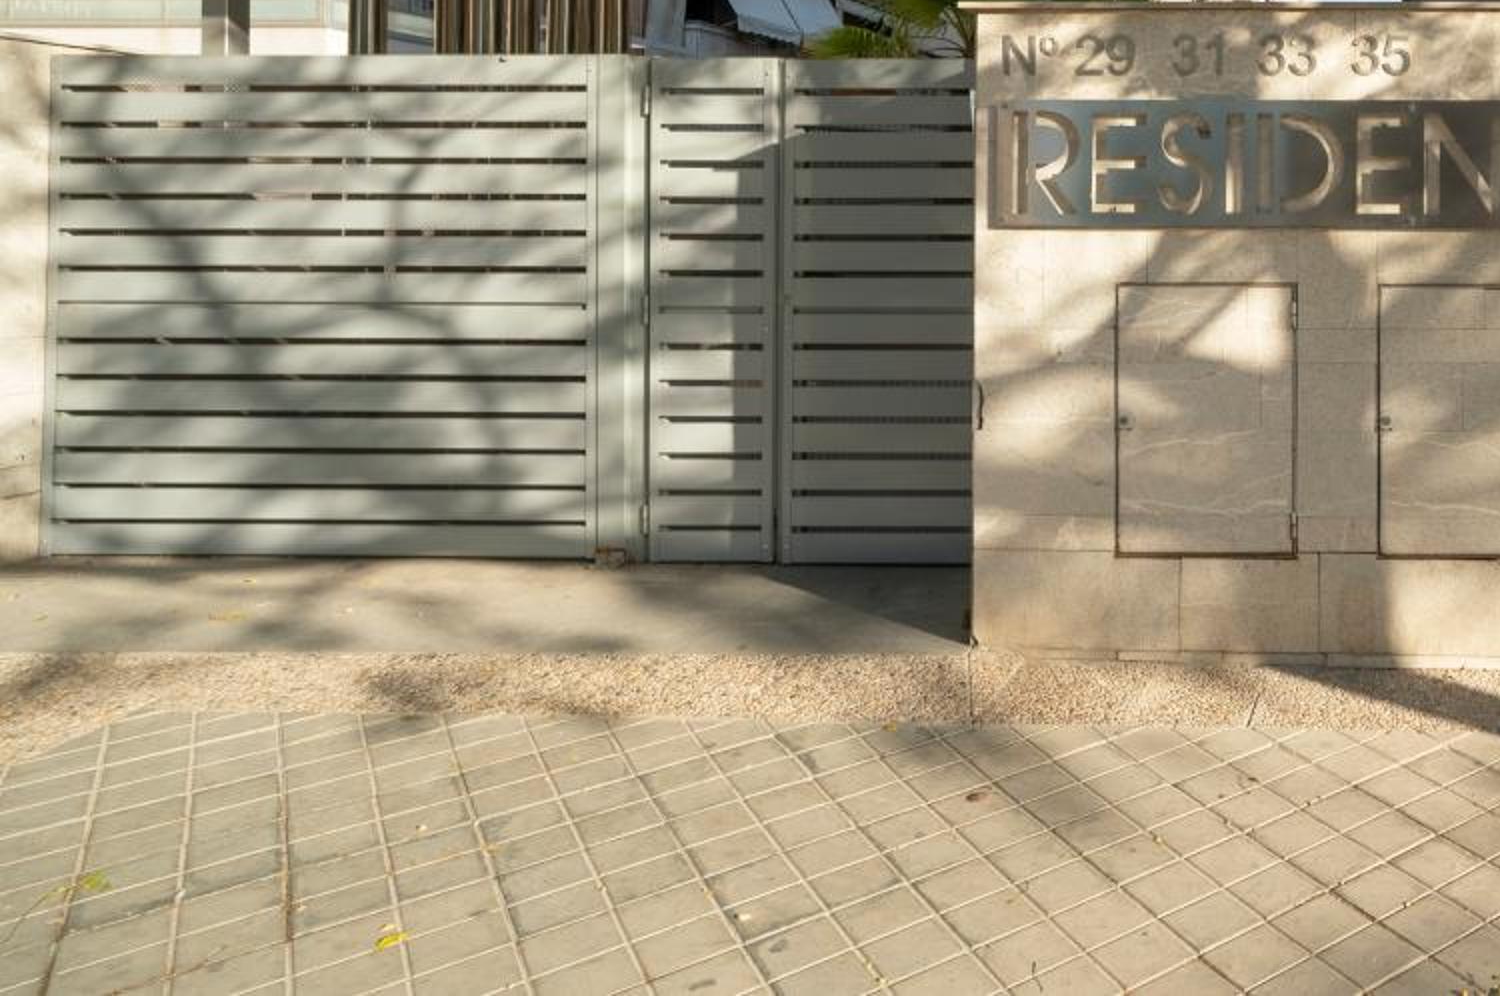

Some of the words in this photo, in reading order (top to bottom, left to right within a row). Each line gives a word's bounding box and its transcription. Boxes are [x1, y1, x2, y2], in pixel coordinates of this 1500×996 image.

[1074, 34, 1136, 78] 29
[1171, 32, 1227, 78] 31
[1256, 34, 1319, 78] 33
[1350, 34, 1412, 78] 35
